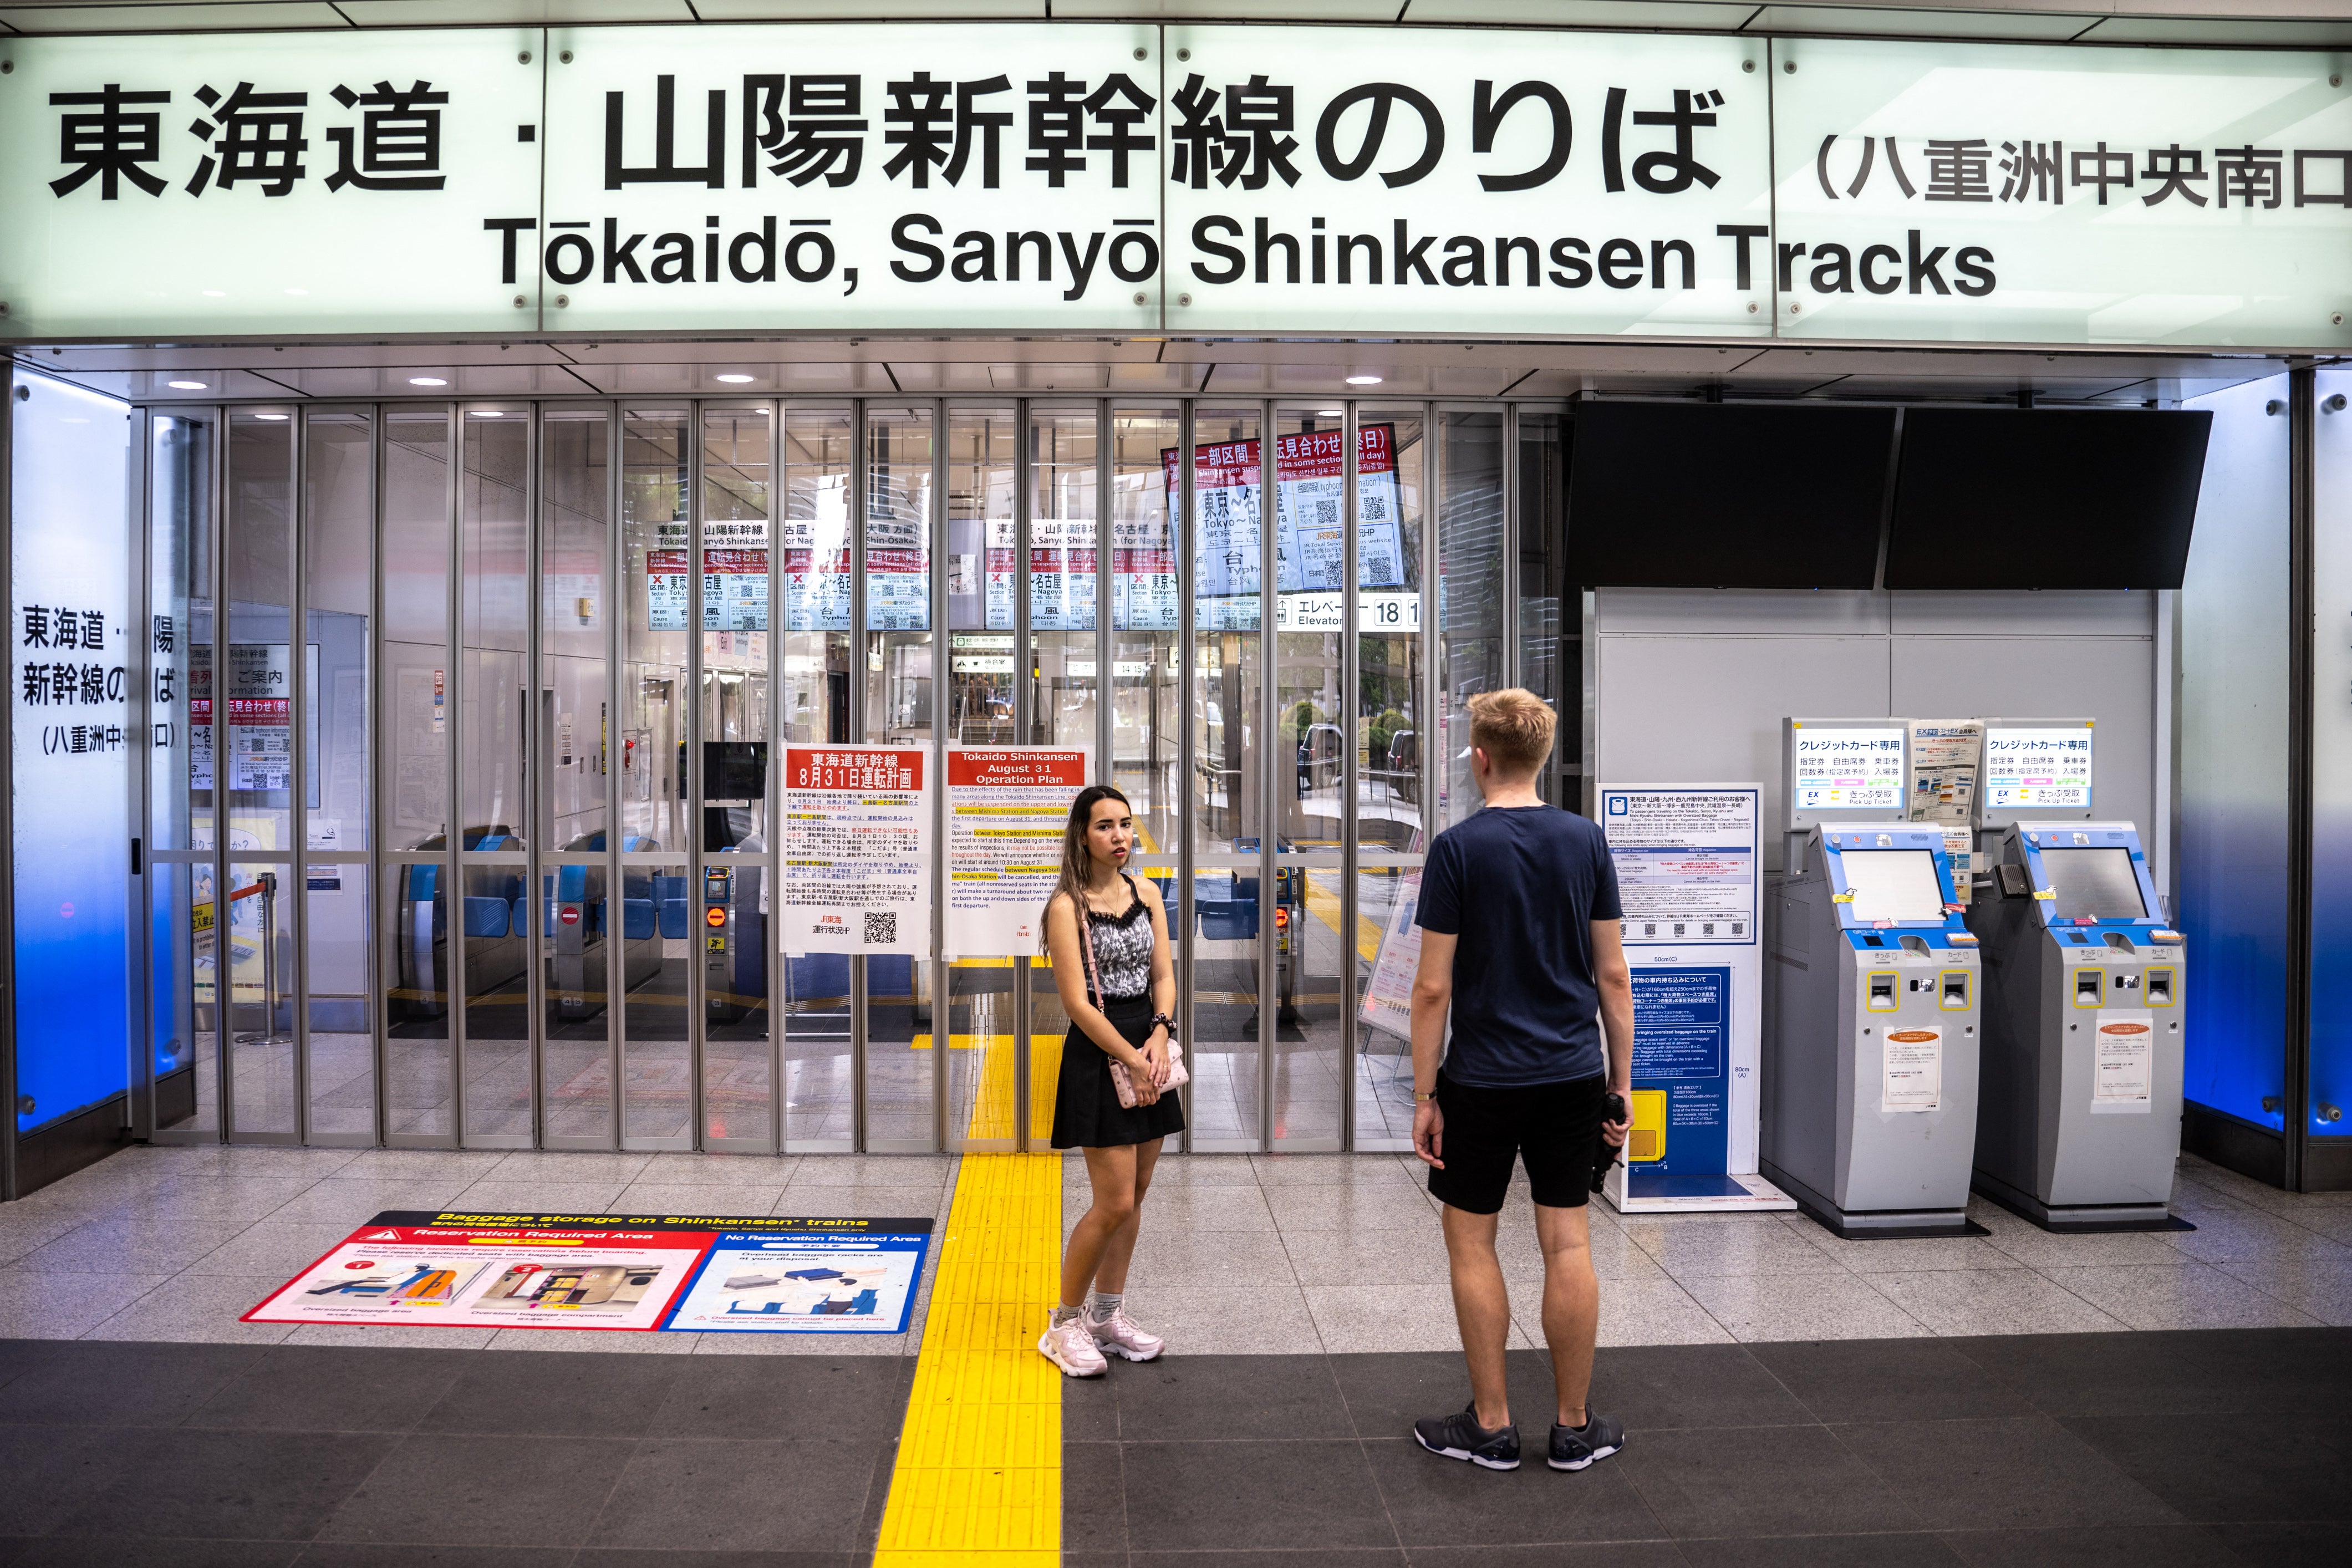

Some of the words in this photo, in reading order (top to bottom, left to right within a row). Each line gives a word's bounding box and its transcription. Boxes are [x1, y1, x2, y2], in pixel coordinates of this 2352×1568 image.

[48, 70, 1724, 201] 東海道・山陽新幹線のりば
[483, 215, 859, 296] Tōkaidō,
[889, 212, 1157, 301] Sanyō
[1190, 214, 1696, 291] Shinkansen
[1716, 223, 1997, 297] Tracks
[1196, 445, 1248, 466] 一部区間
[1199, 467, 1240, 477] Shinkansen
[1367, 450, 1385, 460] day)
[1299, 600, 1368, 613] エレベーー
[1377, 602, 1399, 623] 18
[23, 604, 174, 654] 東海道・陽
[23, 661, 175, 706] 新幹線のば
[1800, 740, 1900, 751] クレジットカード専用
[1990, 740, 2088, 750] クレジットカード専用
[811, 753, 898, 767] 東海道新幹線
[962, 752, 1007, 761] Tokaido
[1010, 752, 1078, 761] Shinkansen
[988, 765, 1030, 773] August
[976, 776, 1034, 785] Operation
[436, 1213, 535, 1223] Baggage
[539, 1214, 623, 1224] storage
[413, 1229, 520, 1238] Reservation
[525, 1231, 607, 1240] Required
